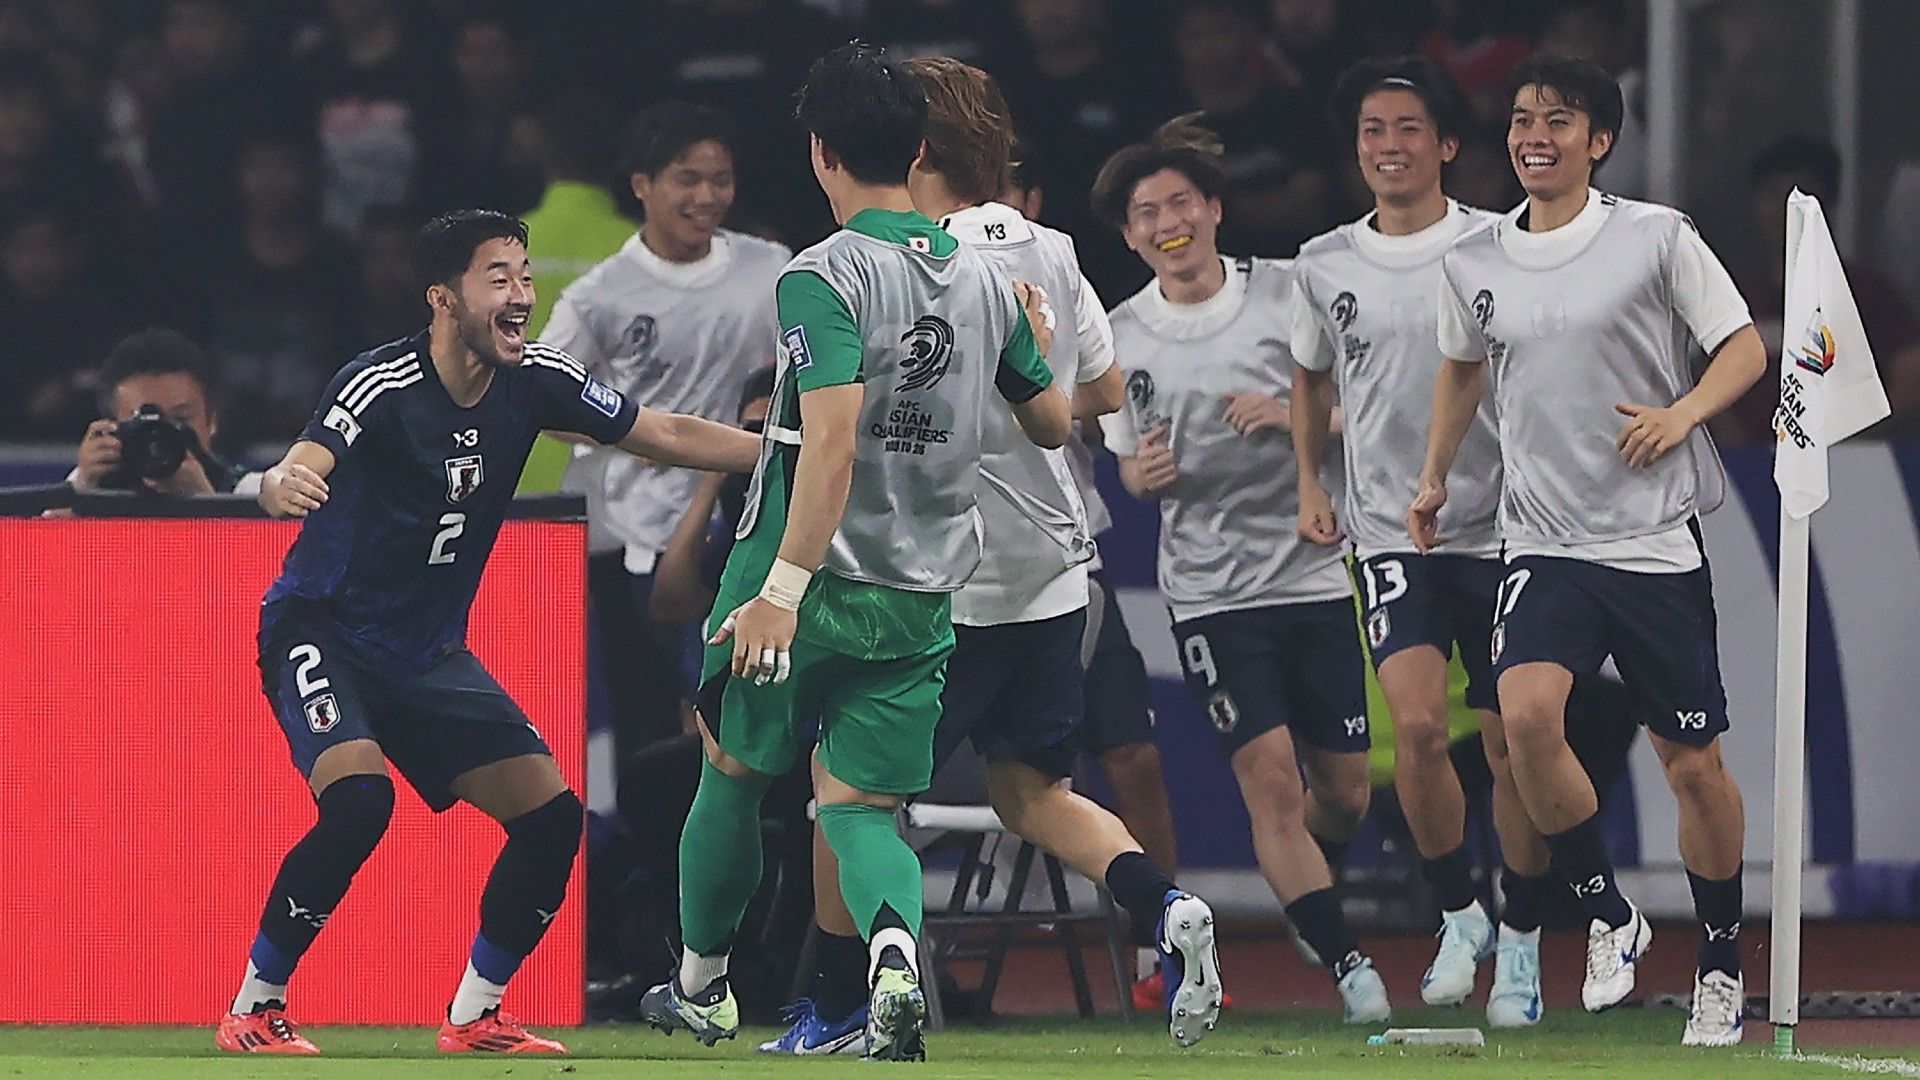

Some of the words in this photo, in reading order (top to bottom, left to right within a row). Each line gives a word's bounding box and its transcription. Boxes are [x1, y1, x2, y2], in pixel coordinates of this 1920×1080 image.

[984, 223, 1006, 241] Y-3
[1786, 373, 1804, 394] AFC
[898, 400, 920, 411] AFC
[453, 429, 479, 448] Y-3
[428, 513, 466, 565] 2
[1363, 560, 1408, 610] 13
[1493, 568, 1531, 625] 17
[289, 644, 330, 698] 2
[1184, 634, 1217, 687] 9
[1676, 711, 1706, 730] Y-3
[1569, 875, 1605, 898] Y-3
[1705, 922, 1740, 941] Y-3
